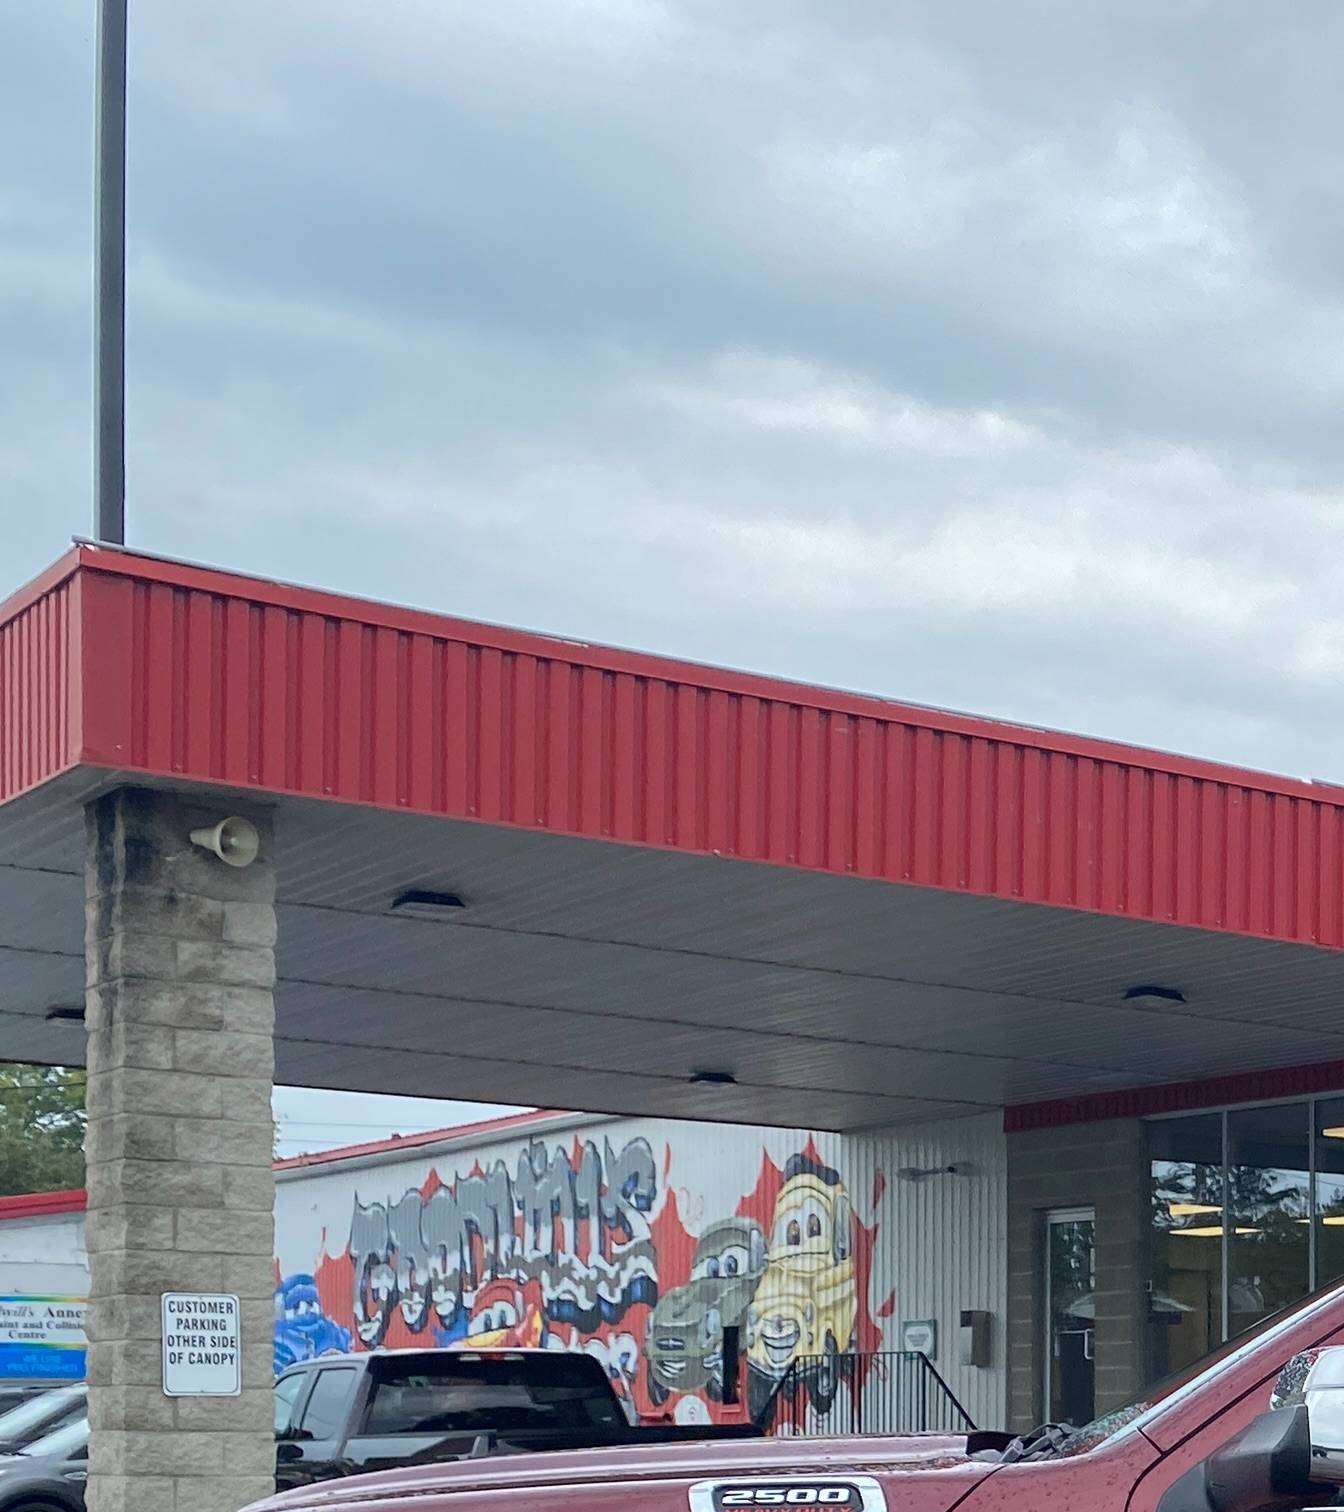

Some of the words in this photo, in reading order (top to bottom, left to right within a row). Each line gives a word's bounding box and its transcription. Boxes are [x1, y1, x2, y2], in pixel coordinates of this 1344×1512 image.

[0, 1305, 34, 1318] will's
[43, 1306, 86, 1318] Anne
[168, 1300, 234, 1314] CUSTOMER
[0, 1321, 18, 1329] aint
[176, 1318, 227, 1331] PARKING
[8, 1330, 47, 1339] Centre
[167, 1335, 206, 1348] OTHER
[210, 1336, 237, 1348] SIDE
[169, 1352, 184, 1365] OF
[188, 1352, 235, 1366] CANOPY
[721, 1488, 850, 1506] 2500
